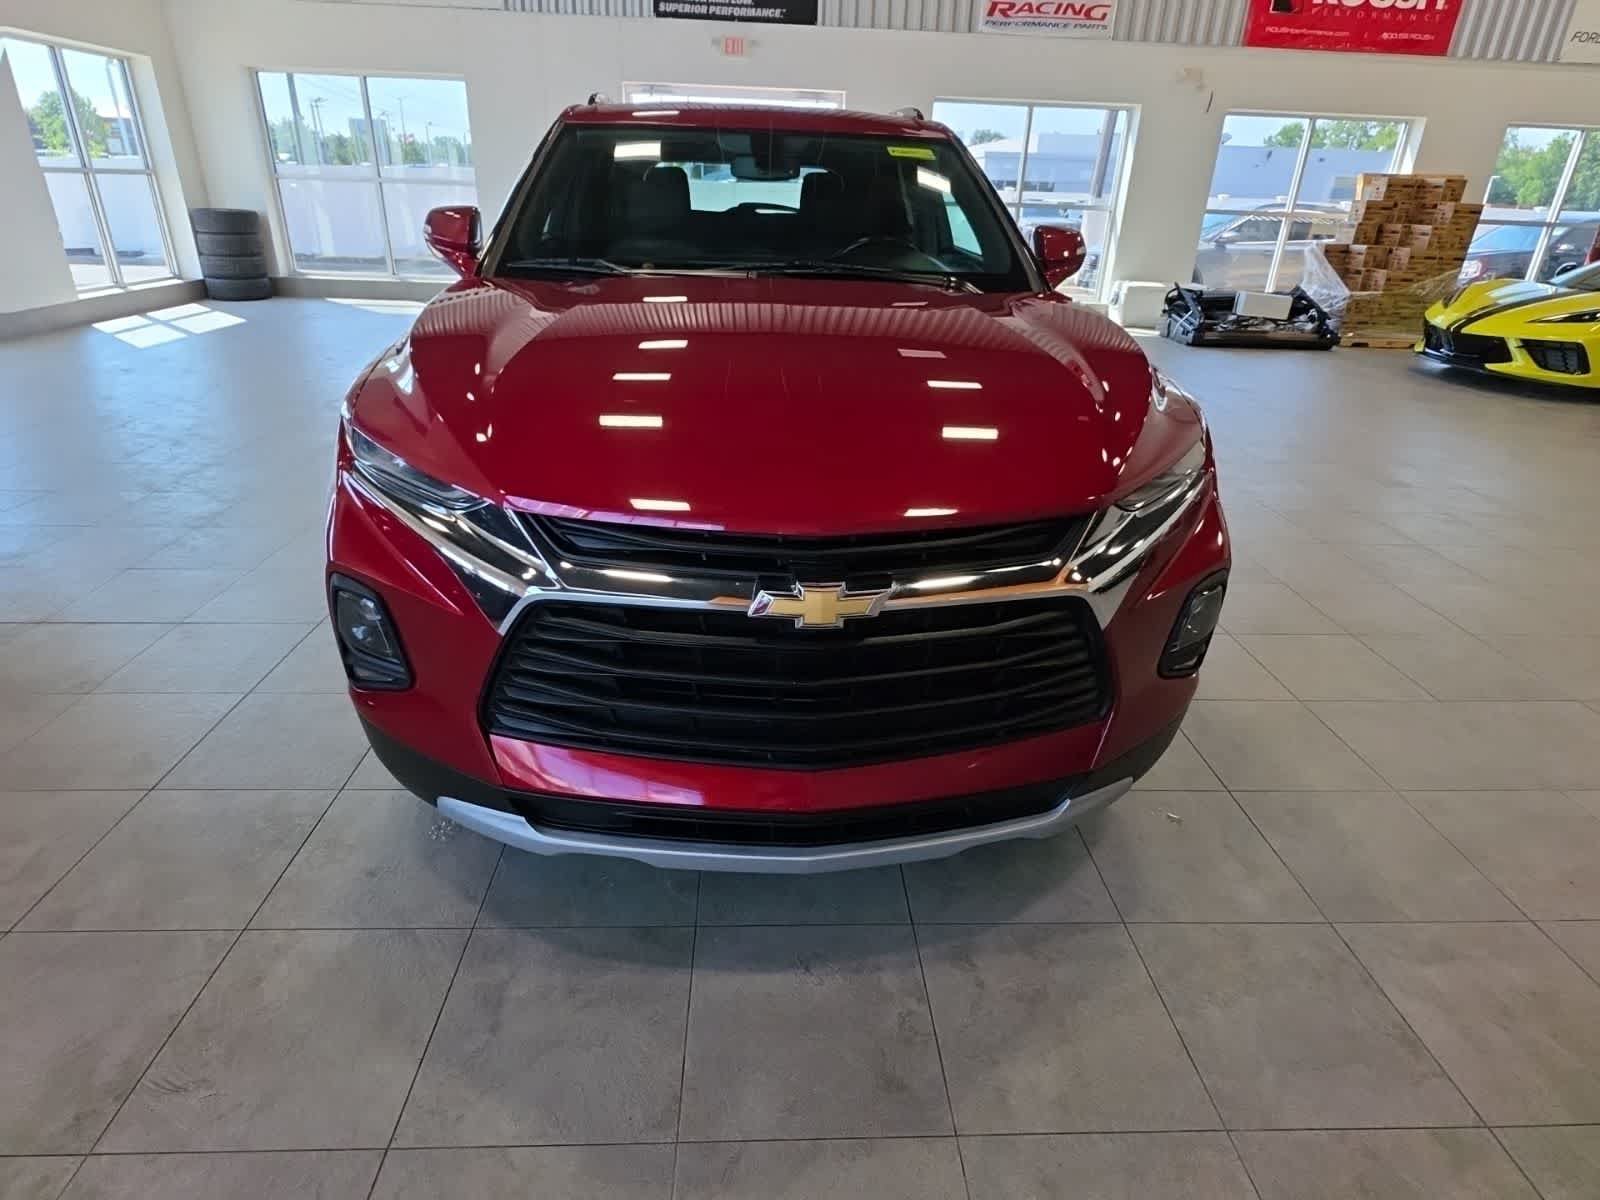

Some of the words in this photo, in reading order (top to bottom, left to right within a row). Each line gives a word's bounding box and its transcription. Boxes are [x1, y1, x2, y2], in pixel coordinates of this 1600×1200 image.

[659, 2, 707, 14] SUPERIOR
[986, 1, 1112, 21] RACING
[985, 20, 1069, 29] PERFORMANCE
